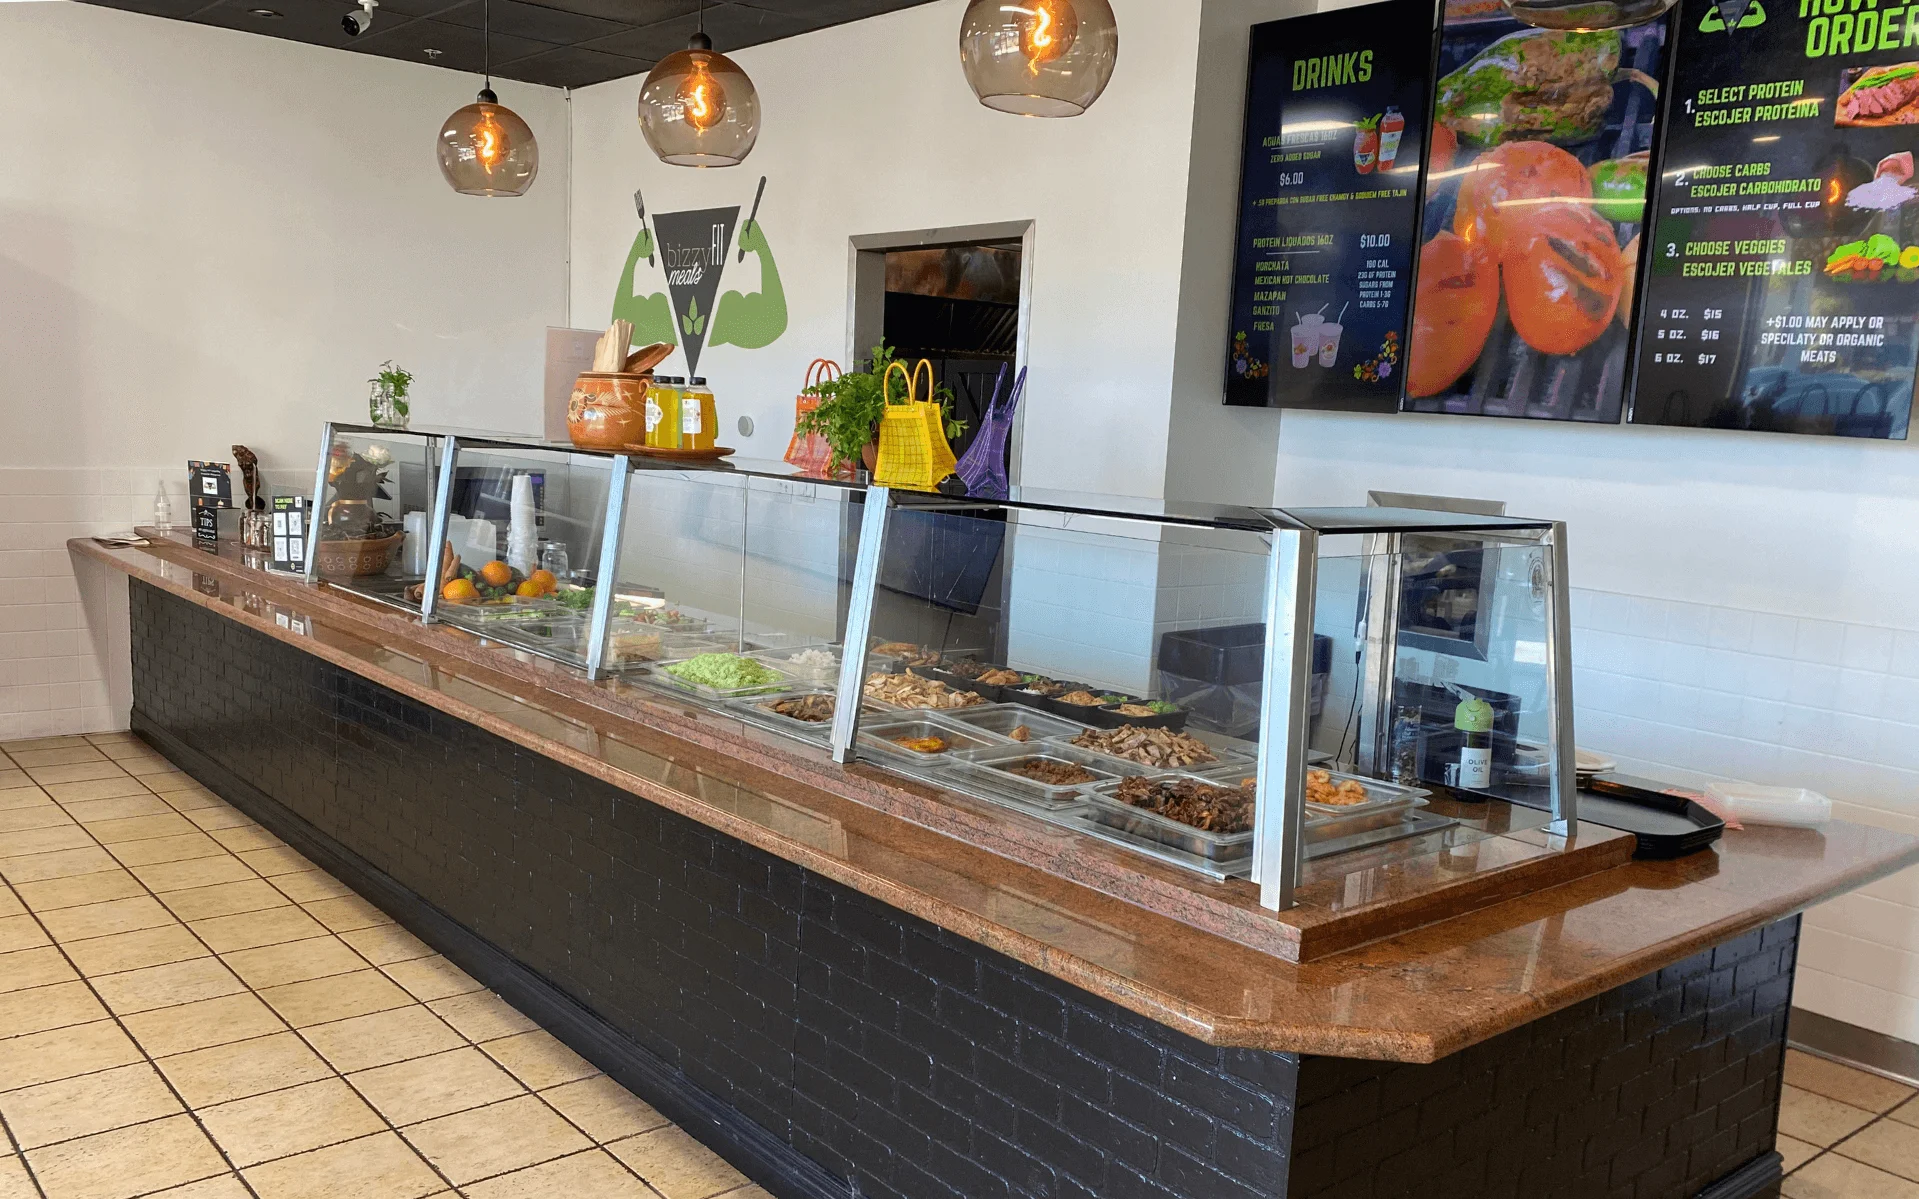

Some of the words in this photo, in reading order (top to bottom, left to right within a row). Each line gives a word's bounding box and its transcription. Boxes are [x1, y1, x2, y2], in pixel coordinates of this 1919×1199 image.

[1806, 5, 1919, 58] ORDER
[1292, 50, 1374, 91] DRINKS
[1684, 98, 1696, 114] 1.
[1698, 86, 1746, 106] SELECT
[1748, 80, 1804, 100] PROTEIN
[1695, 108, 1752, 127] ESCOJER
[1755, 102, 1820, 122] PROTEINA
[1262, 134, 1286, 148] AGUAS
[1287, 131, 1318, 144] FRESCAS
[1280, 172, 1304, 186] $6.00
[1675, 171, 1688, 186] 2.
[1693, 164, 1732, 180] CHOOSE
[1736, 162, 1771, 176] CARBS
[1690, 184, 1736, 198] ESCOJER
[1739, 178, 1822, 195] CARBOHIDRATO
[1763, 202, 1780, 210] CUP,
[1253, 237, 1280, 248] PROTEIN
[1360, 234, 1390, 249] $10.00
[667, 242, 711, 273] bizzy
[712, 224, 724, 265] FIT
[1666, 242, 1680, 257] 3.
[1685, 241, 1731, 256] CHOOSE
[1734, 240, 1786, 254] VEGGIES
[1256, 261, 1289, 272] HORCHATA
[1378, 259, 1389, 268] CAL
[1683, 262, 1735, 277] ESCOJER
[1739, 260, 1812, 276] VEGETALES
[668, 262, 702, 285] meals
[1254, 276, 1281, 285] MEXICAN
[1282, 275, 1294, 284] HOT
[1294, 274, 1330, 284] CHOCOLATE
[1254, 291, 1286, 301] MAZAPAN
[1660, 309, 1667, 318] 4
[1672, 309, 1689, 318] OZ.
[1704, 308, 1722, 320] $15
[1253, 322, 1274, 331] FRESA
[1766, 316, 1802, 328] +$1.00
[1805, 316, 1829, 328] MAY
[1831, 316, 1866, 329] APPLY
[1868, 316, 1884, 329] OR
[1658, 330, 1665, 339] 5
[1669, 330, 1686, 339] OZ.
[1701, 329, 1720, 341] $16
[1761, 333, 1817, 345] SPECILATY
[1819, 334, 1834, 345] OR
[1836, 334, 1884, 346] ORGANIC
[1655, 353, 1662, 362] 6
[1666, 354, 1683, 363] OZ.
[1698, 353, 1716, 365] $17
[1801, 350, 1837, 363] MEATS
[200, 517, 213, 528] TIPS
